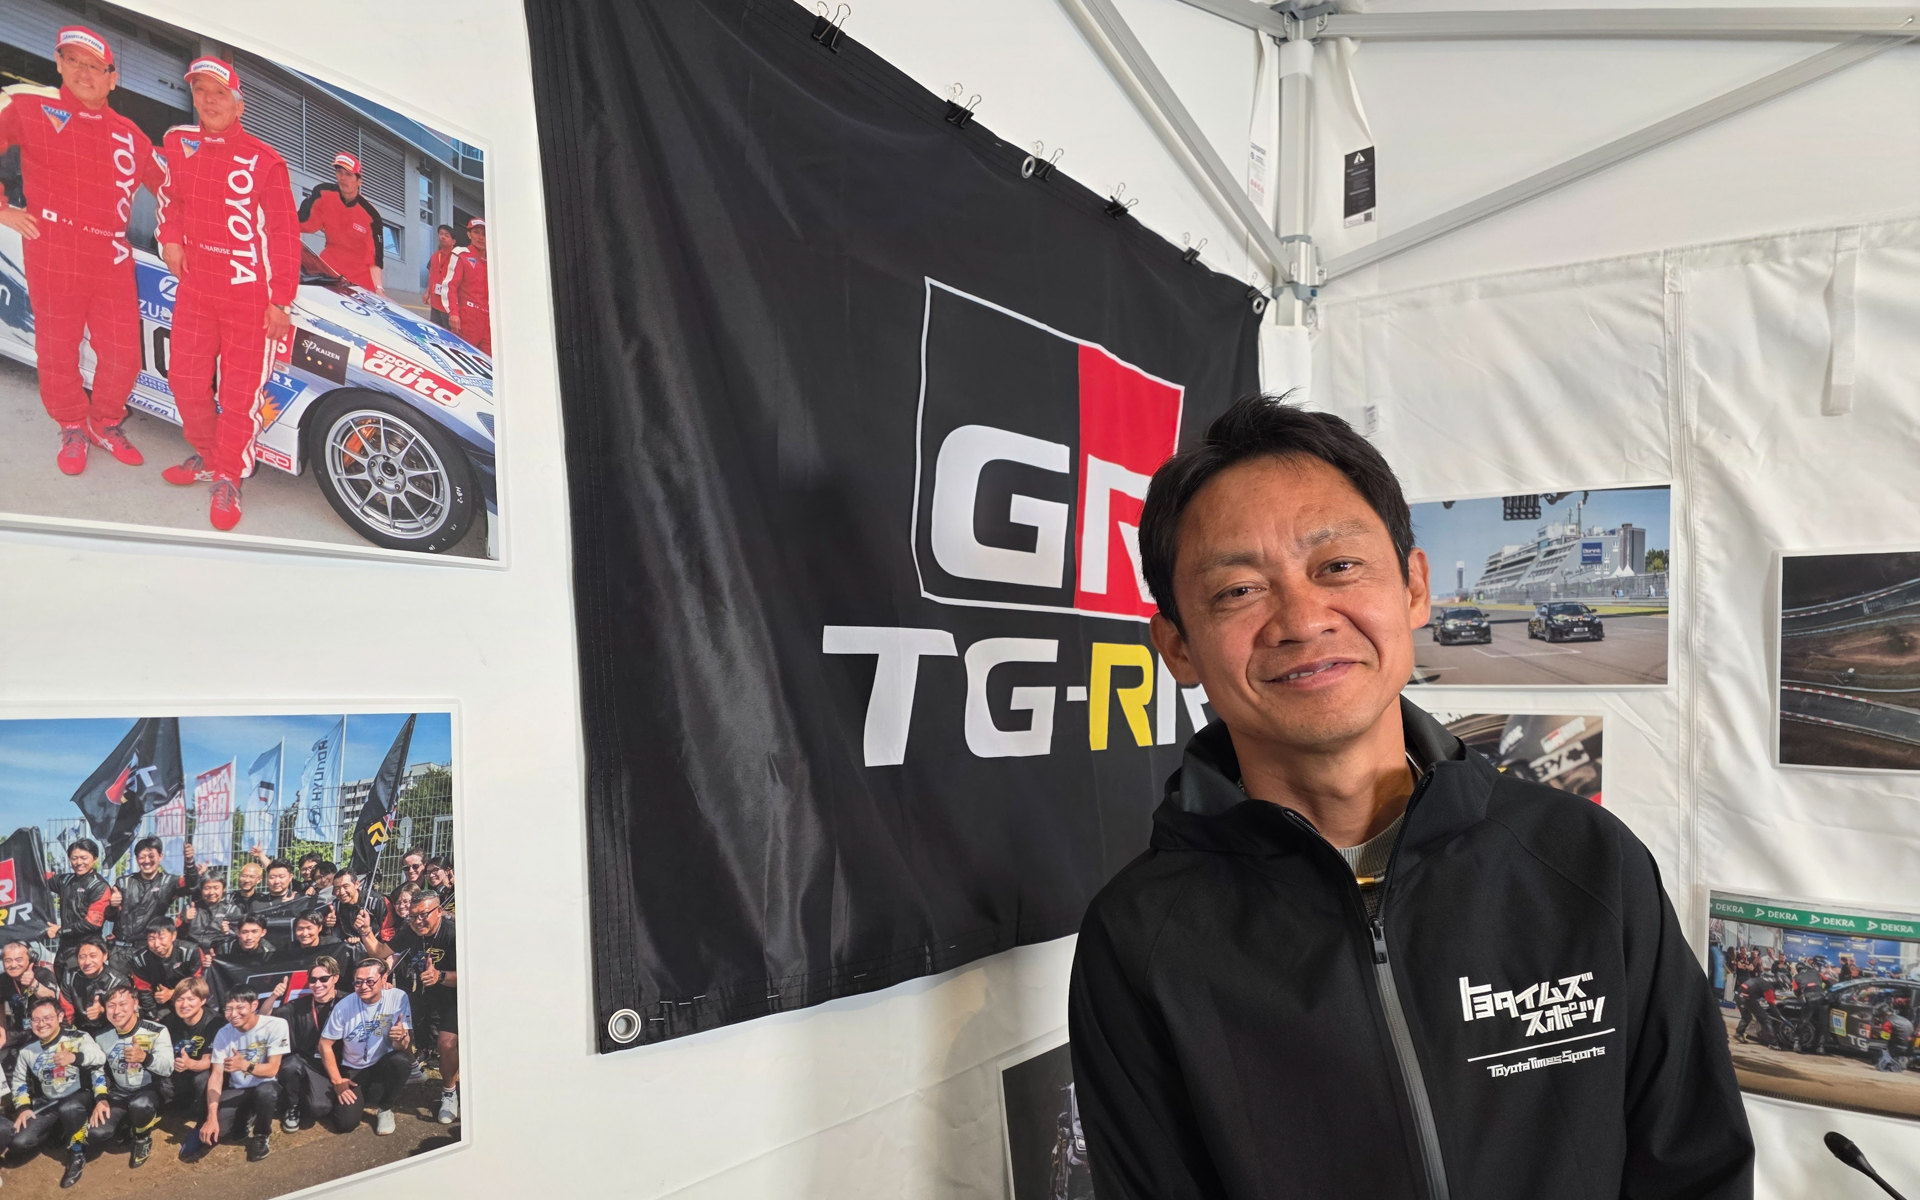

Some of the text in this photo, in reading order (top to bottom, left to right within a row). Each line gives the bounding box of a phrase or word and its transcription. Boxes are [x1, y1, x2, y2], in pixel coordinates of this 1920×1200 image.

[225, 154, 259, 285] TOYOTA
[363, 358, 460, 408] auto
[373, 350, 425, 376] sport
[931, 424, 1156, 604] GR
[311, 738, 329, 802] HYUNDA
[1716, 904, 1744, 914] DEKRA
[1768, 911, 1798, 921] DEKRA
[1823, 917, 1855, 928] DEKRA
[1881, 923, 1914, 934] DEKRA
[1459, 971, 1594, 1021] トヨタイムズ
[1520, 996, 1605, 1037] スポーツ
